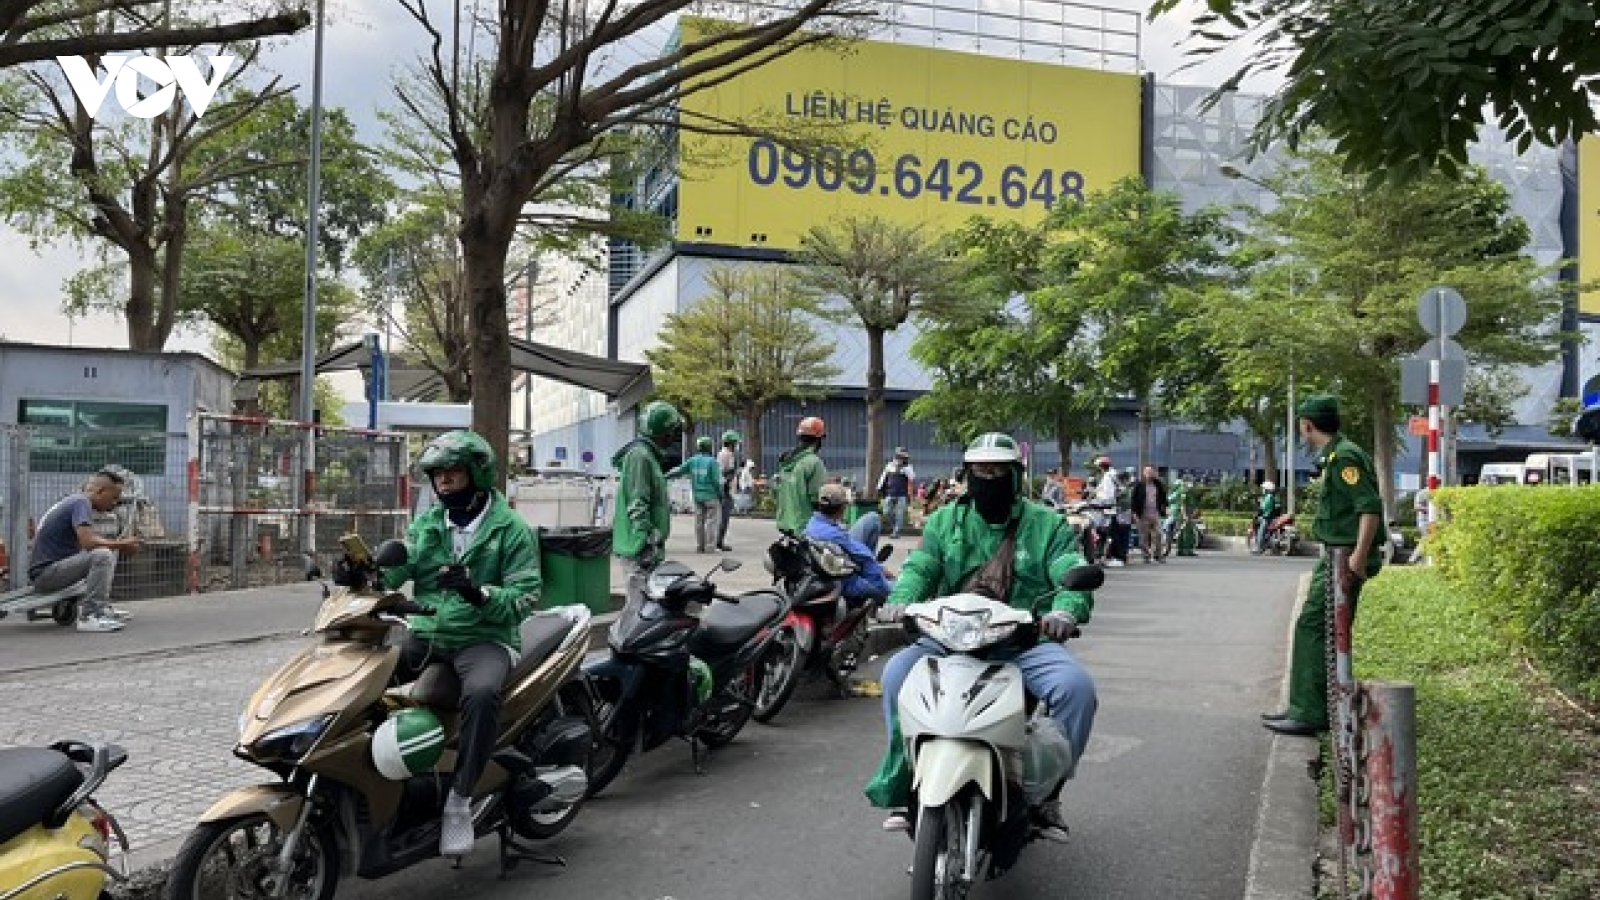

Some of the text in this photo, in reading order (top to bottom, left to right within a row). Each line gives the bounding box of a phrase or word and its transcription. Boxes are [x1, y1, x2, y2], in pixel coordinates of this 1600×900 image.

[786, 90, 1058, 144] LIÊN HỆ QUẢNG CÁO
